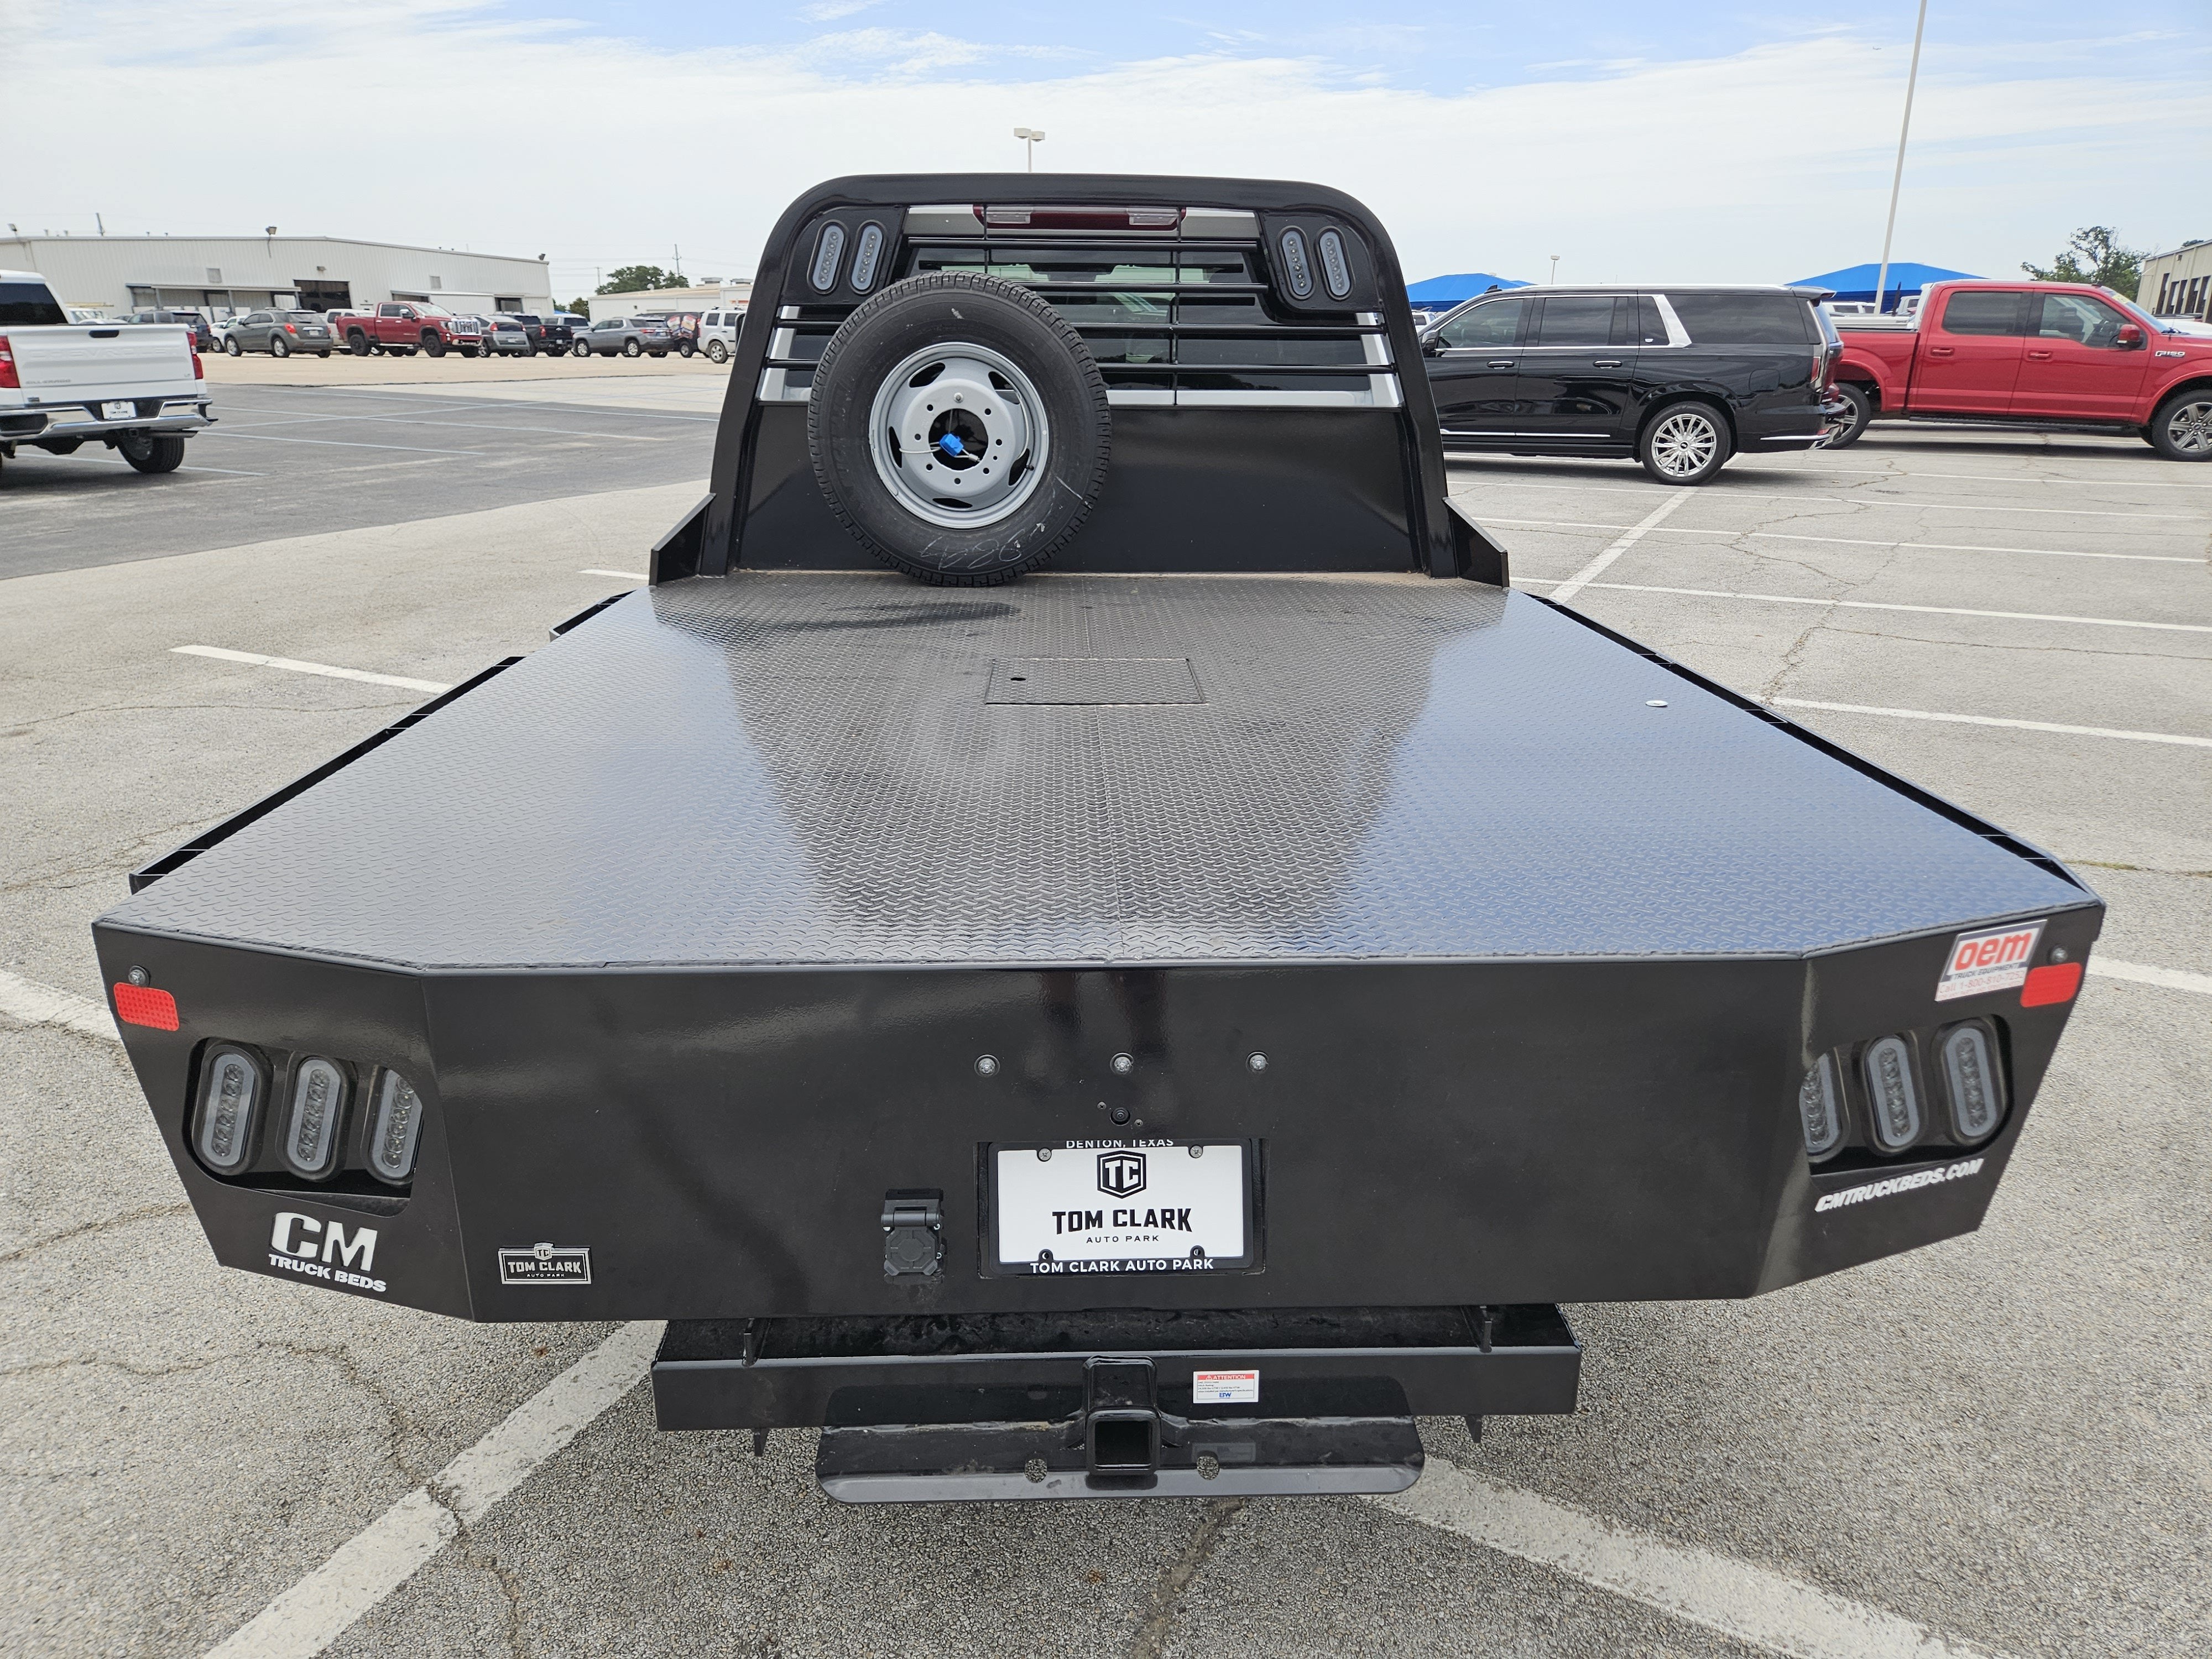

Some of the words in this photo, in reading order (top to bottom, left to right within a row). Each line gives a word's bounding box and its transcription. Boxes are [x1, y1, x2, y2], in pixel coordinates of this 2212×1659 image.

[1955, 932, 2032, 971] oem
[1940, 980, 1956, 993] Call
[1954, 971, 1976, 979] TRUCK
[1104, 1159, 1139, 1189] TC
[1814, 1158, 1984, 1212] CMTRUCKBEDS.COM
[1052, 1210, 1103, 1234] TOM
[1113, 1208, 1192, 1232] CLARK
[272, 1212, 378, 1271] CM
[268, 1254, 332, 1280] TRUCK
[335, 1270, 387, 1292] BEDS
[508, 1262, 535, 1273] TOM
[539, 1262, 582, 1274] CLARK
[1030, 1262, 1063, 1274] TOM
[1070, 1260, 1120, 1272] CLARK
[1125, 1259, 1167, 1271] AUTO
[1173, 1259, 1214, 1270] PARK
